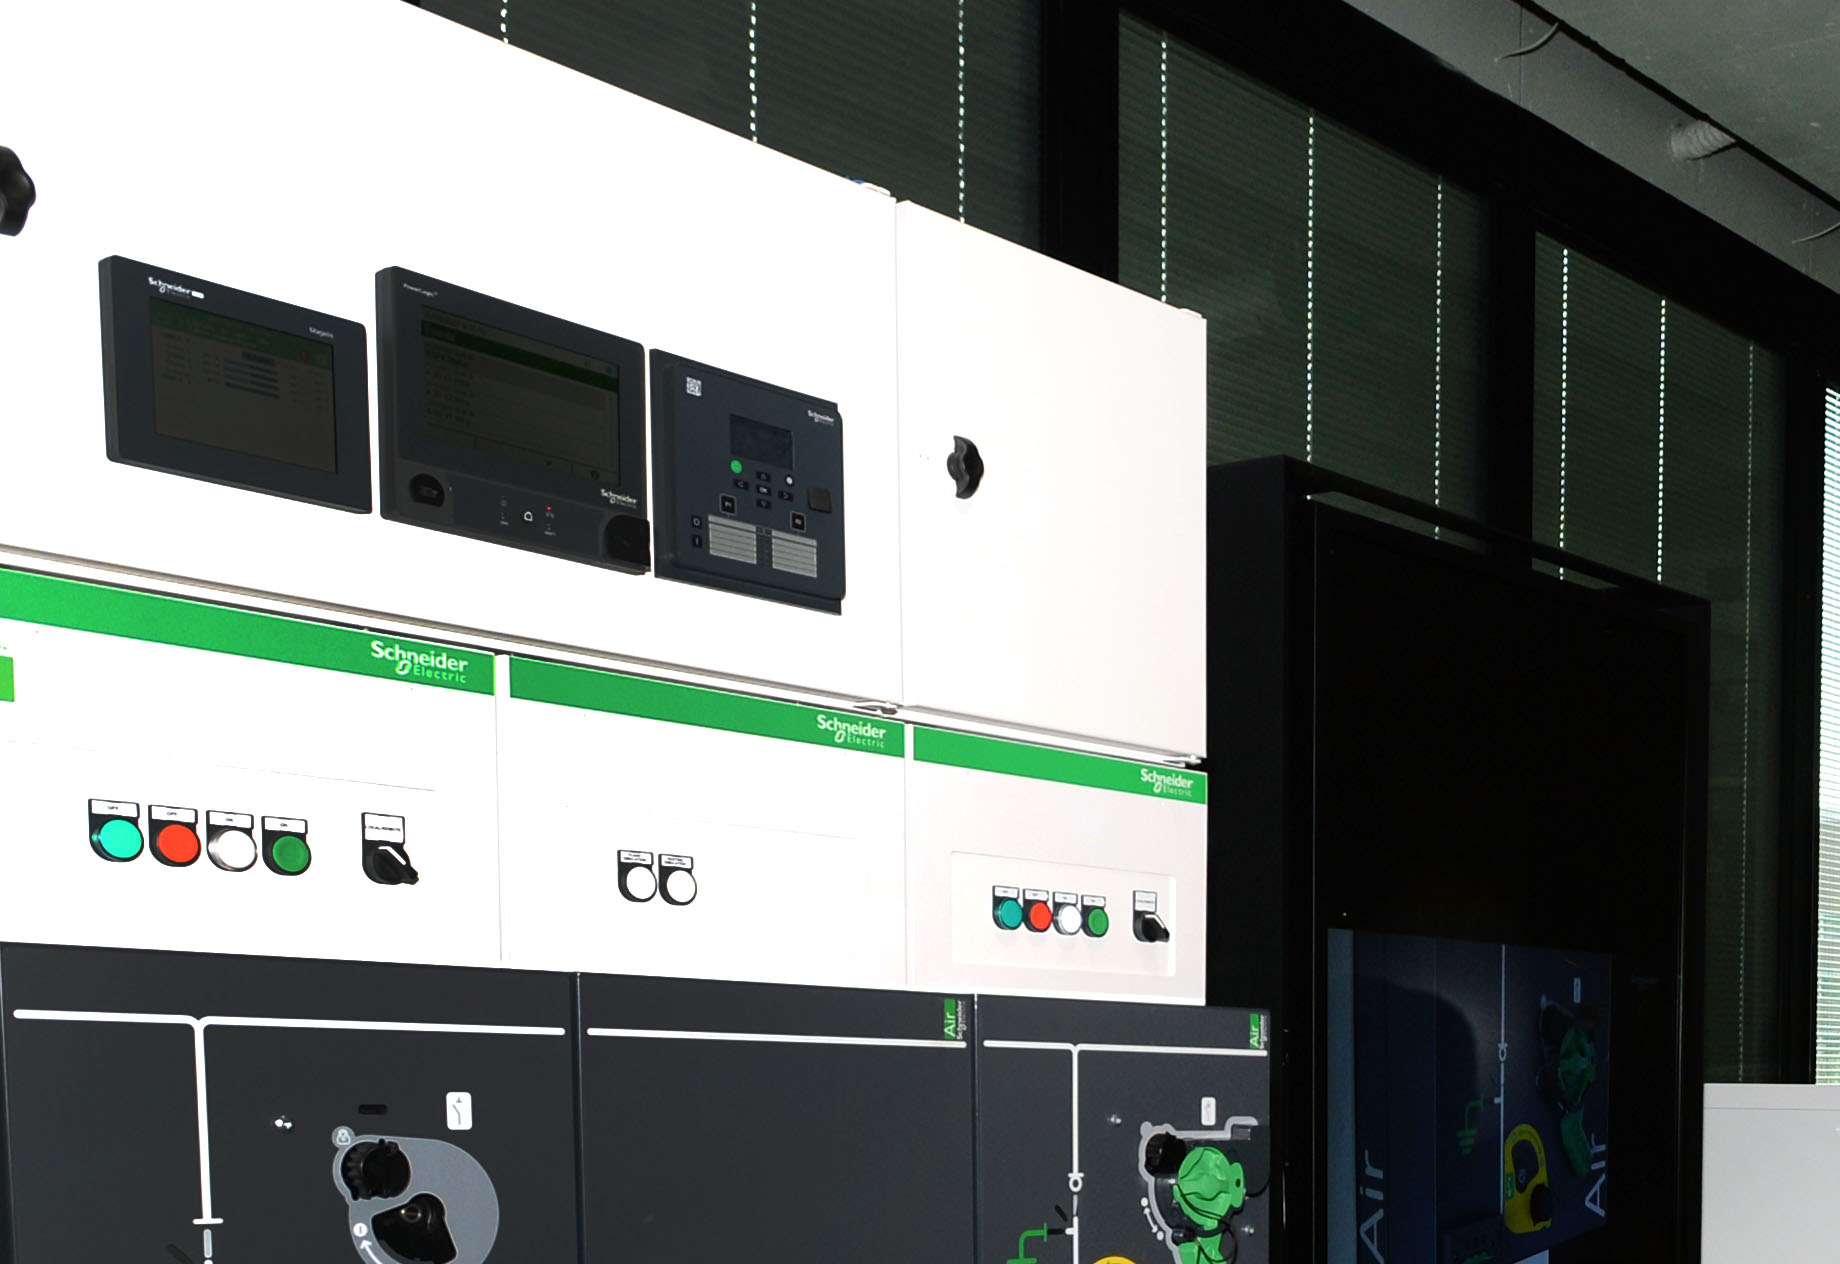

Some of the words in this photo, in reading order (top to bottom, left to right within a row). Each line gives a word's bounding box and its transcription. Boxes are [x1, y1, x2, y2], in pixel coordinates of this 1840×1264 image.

[370, 639, 469, 674] Schneider
[412, 662, 468, 685] Electric
[816, 713, 887, 742] Schneider
[846, 732, 886, 749] Electric
[1140, 767, 1194, 790] Schneider
[1162, 785, 1193, 798] Electric
[944, 1012, 956, 1038] Air
[1249, 1025, 1260, 1049] Air
[1584, 1132, 1608, 1219] Air
